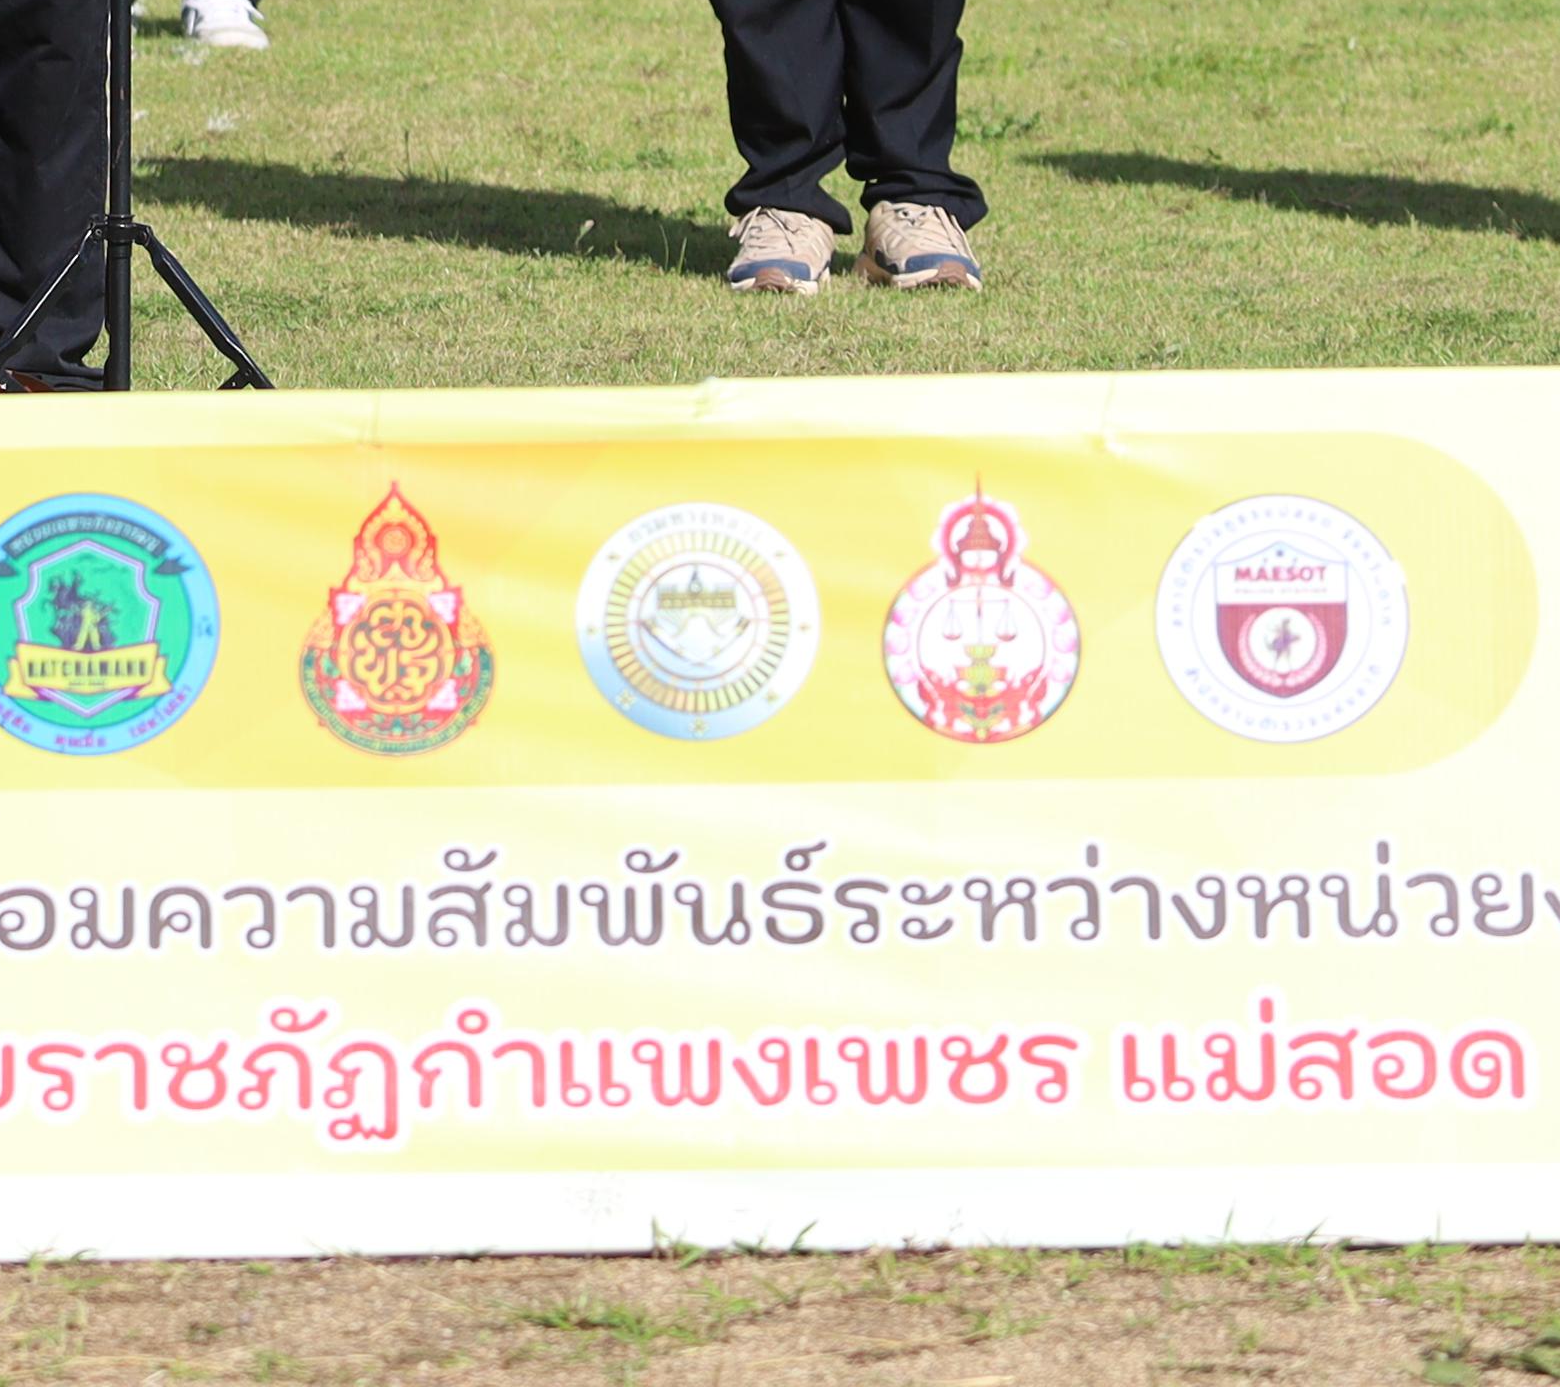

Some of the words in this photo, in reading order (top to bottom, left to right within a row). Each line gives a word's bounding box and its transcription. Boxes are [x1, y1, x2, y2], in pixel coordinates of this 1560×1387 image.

[1234, 564, 1328, 582] MAESOT
[1121, 995, 1528, 1104] แม่สอด
